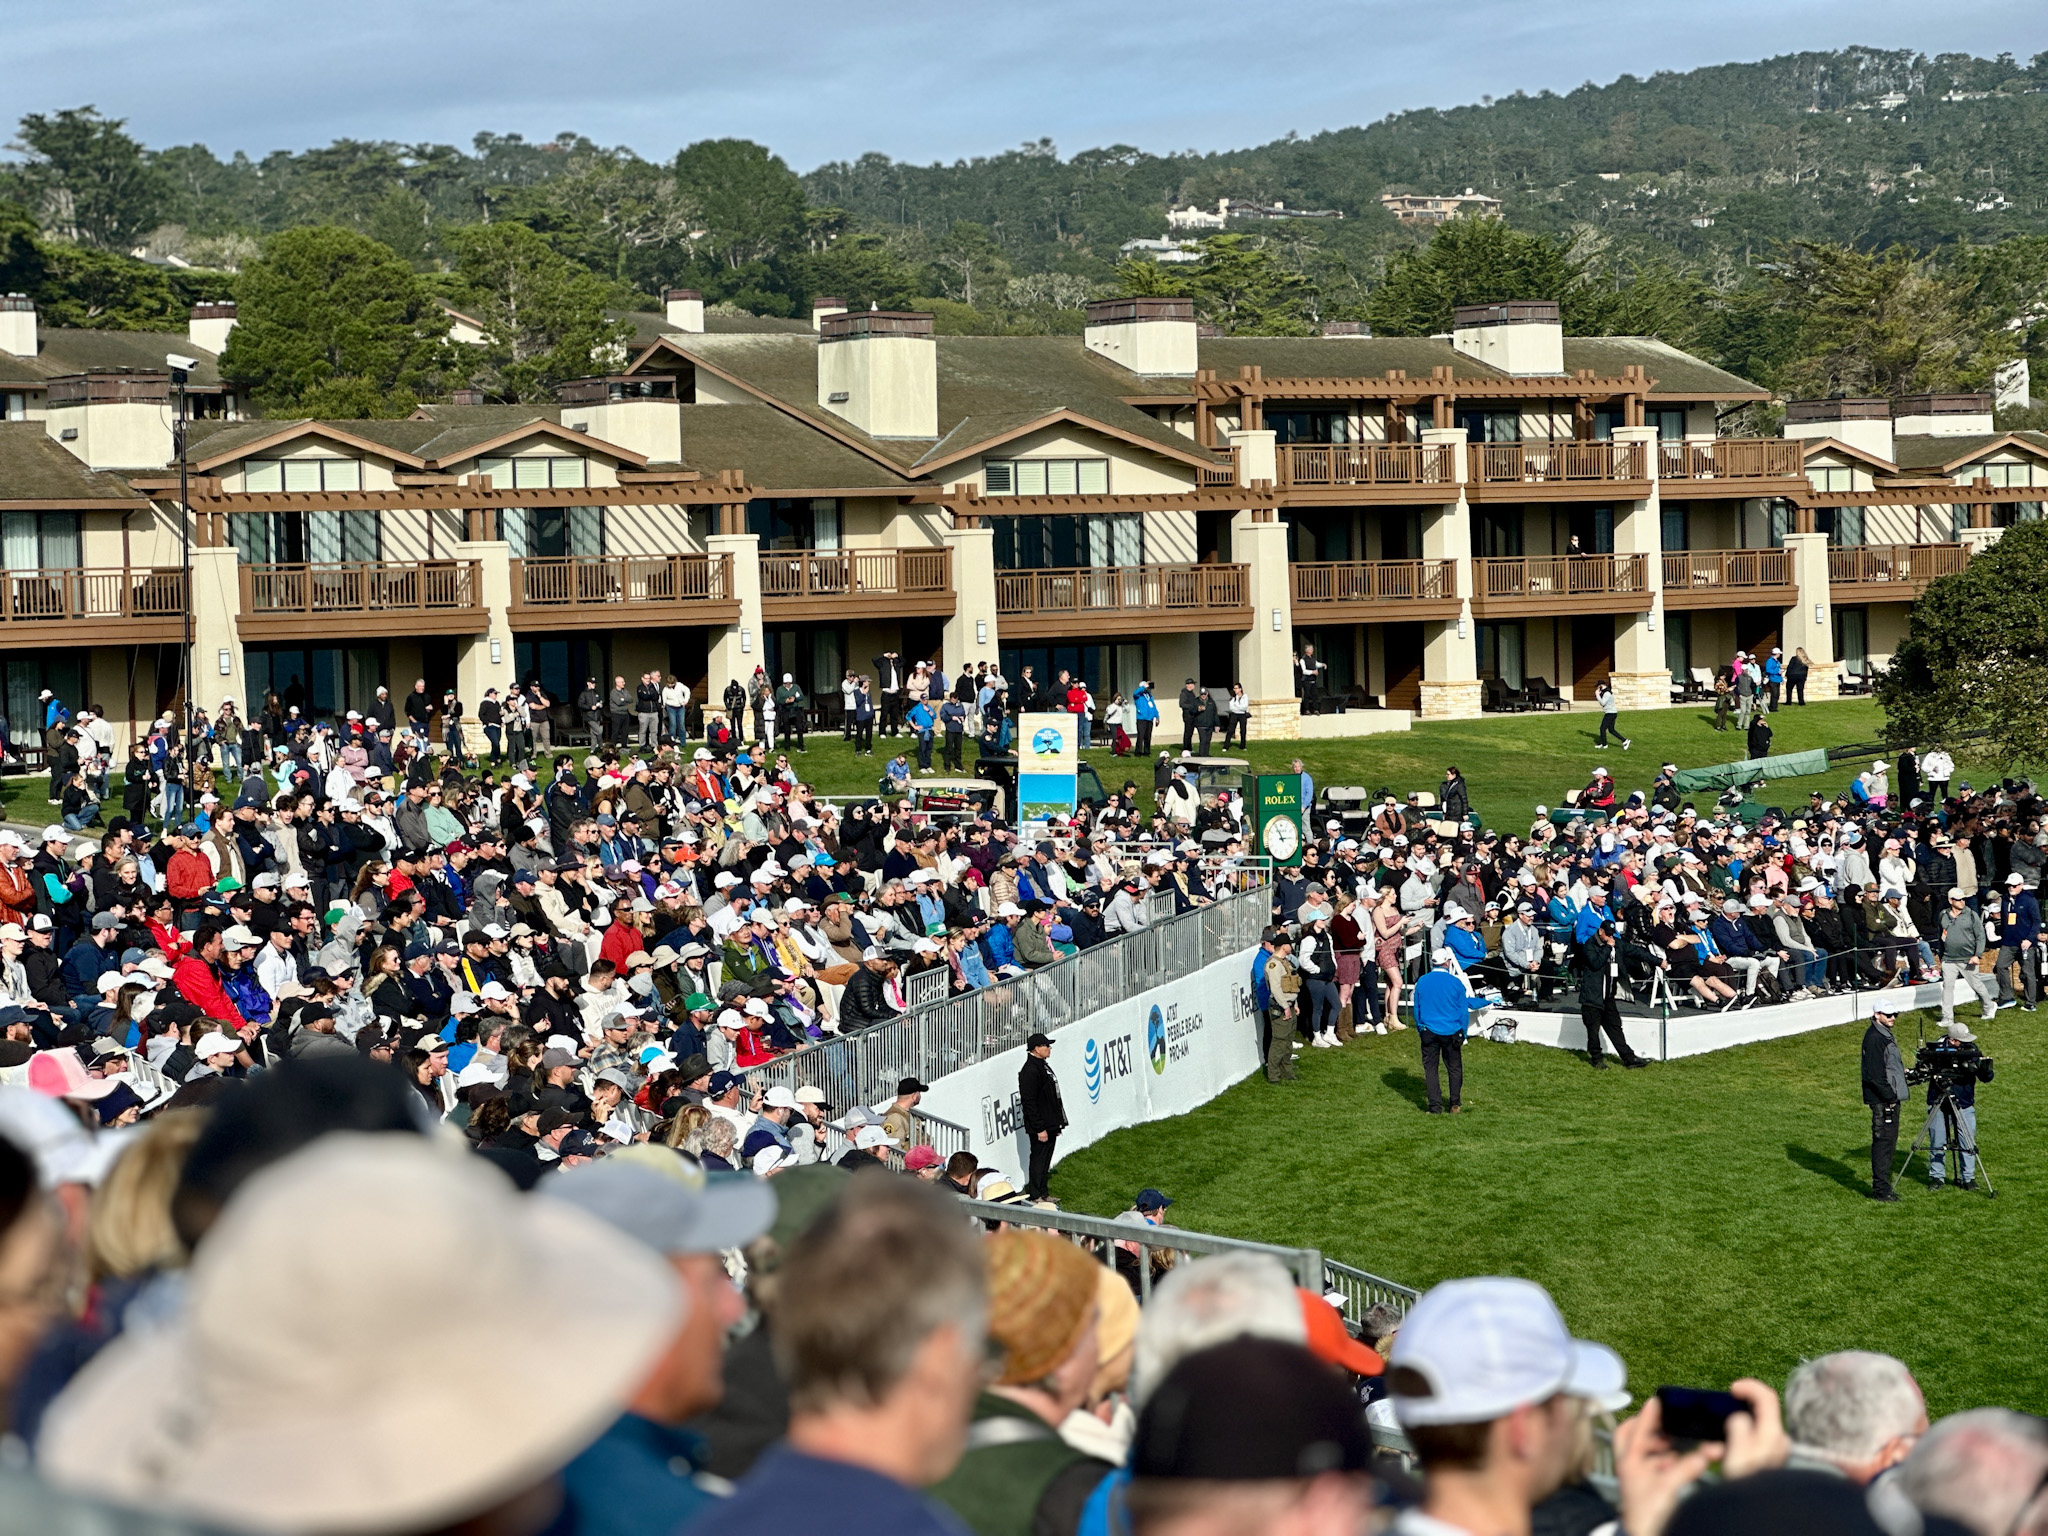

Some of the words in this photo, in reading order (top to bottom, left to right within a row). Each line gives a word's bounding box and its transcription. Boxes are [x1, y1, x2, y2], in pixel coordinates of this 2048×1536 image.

[1265, 795, 1296, 805] ROLEX
[1166, 1003, 1178, 1023] AT&T
[1167, 1022, 1185, 1043] PEBBLE
[1185, 1012, 1203, 1035] BEACH
[1103, 1034, 1132, 1084] AT&T
[1169, 1039, 1189, 1064] PRO-AM
